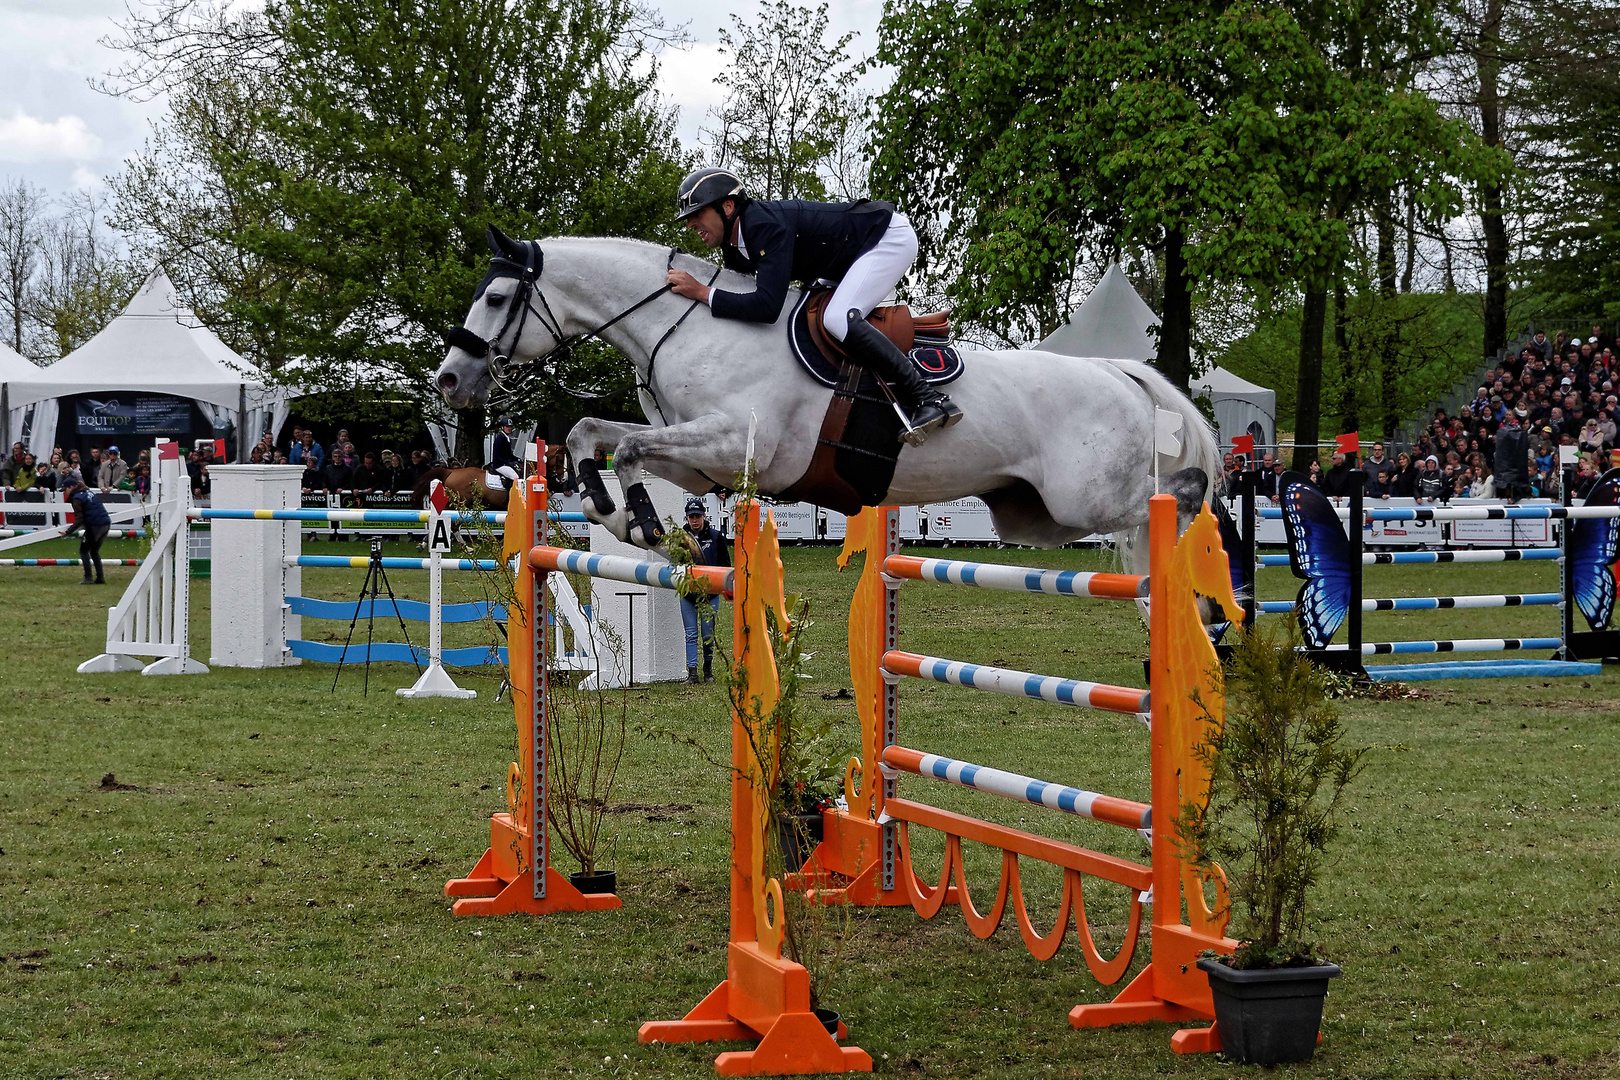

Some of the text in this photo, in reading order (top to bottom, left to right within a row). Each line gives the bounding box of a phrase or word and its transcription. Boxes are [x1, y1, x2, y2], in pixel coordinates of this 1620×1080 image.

[78, 416, 132, 427] EQUITOP
[365, 494, 412, 502] Médias-Servi
[788, 511, 811, 520] Bettignies
[431, 519, 450, 550] A
